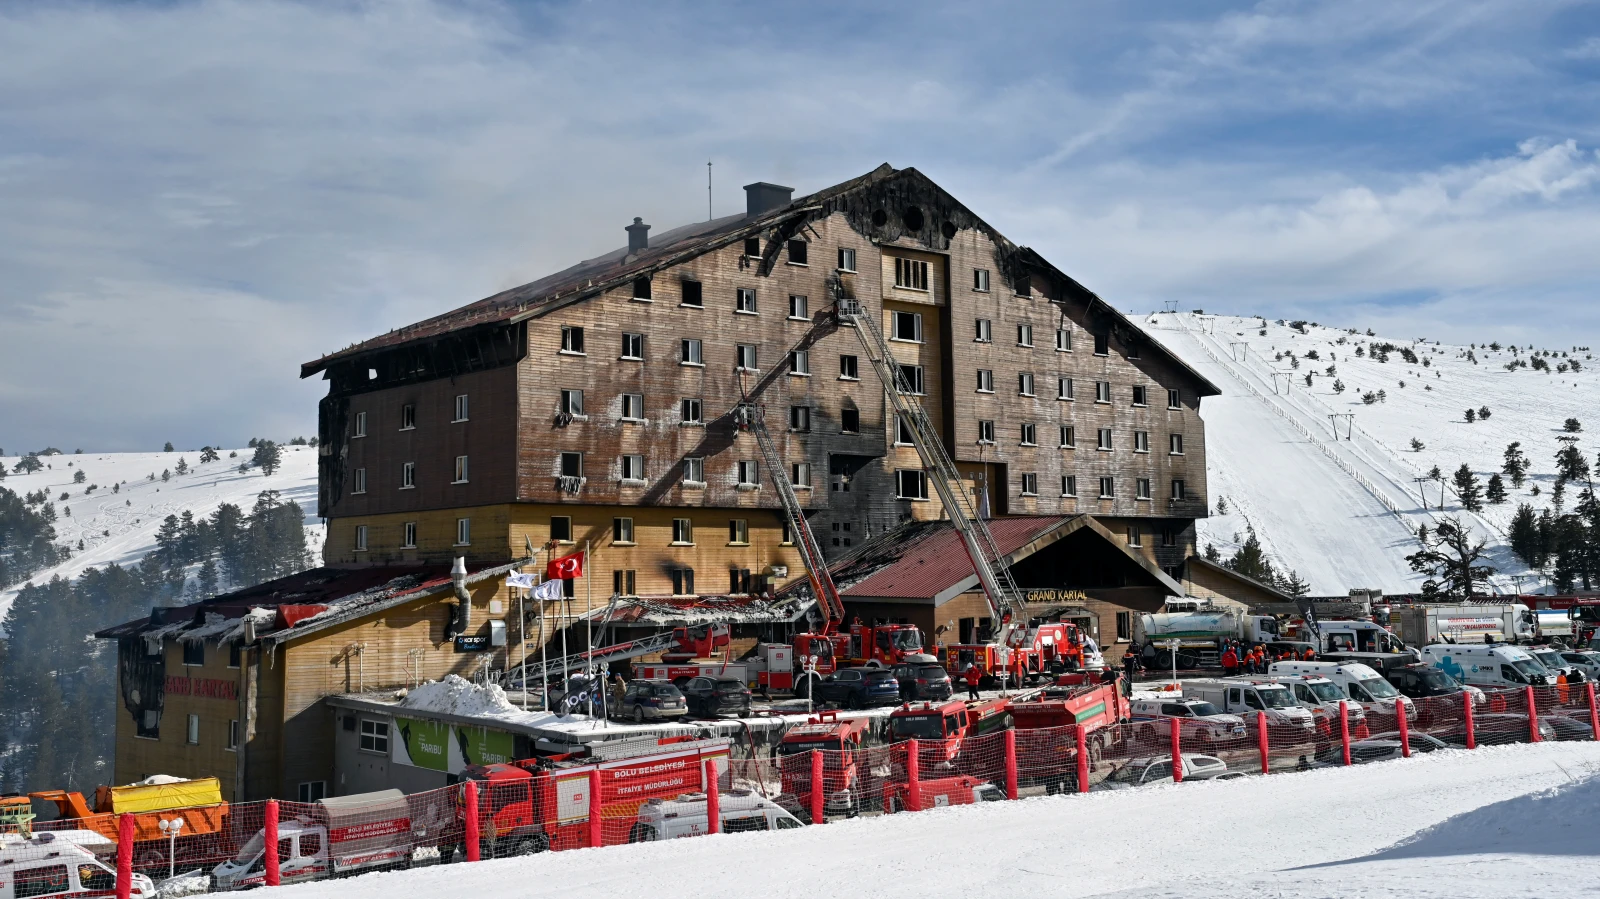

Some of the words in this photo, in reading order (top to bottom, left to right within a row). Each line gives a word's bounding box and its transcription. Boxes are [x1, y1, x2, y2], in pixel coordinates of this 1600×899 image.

[1028, 590, 1056, 601] GRAND
[1058, 590, 1087, 600] KARTAL
[165, 675, 191, 696] AND
[194, 678, 238, 701] KARTAL
[614, 768, 637, 779] BOLU
[638, 759, 686, 775] BELEDİYESİ
[617, 784, 643, 795] İTFAİYE
